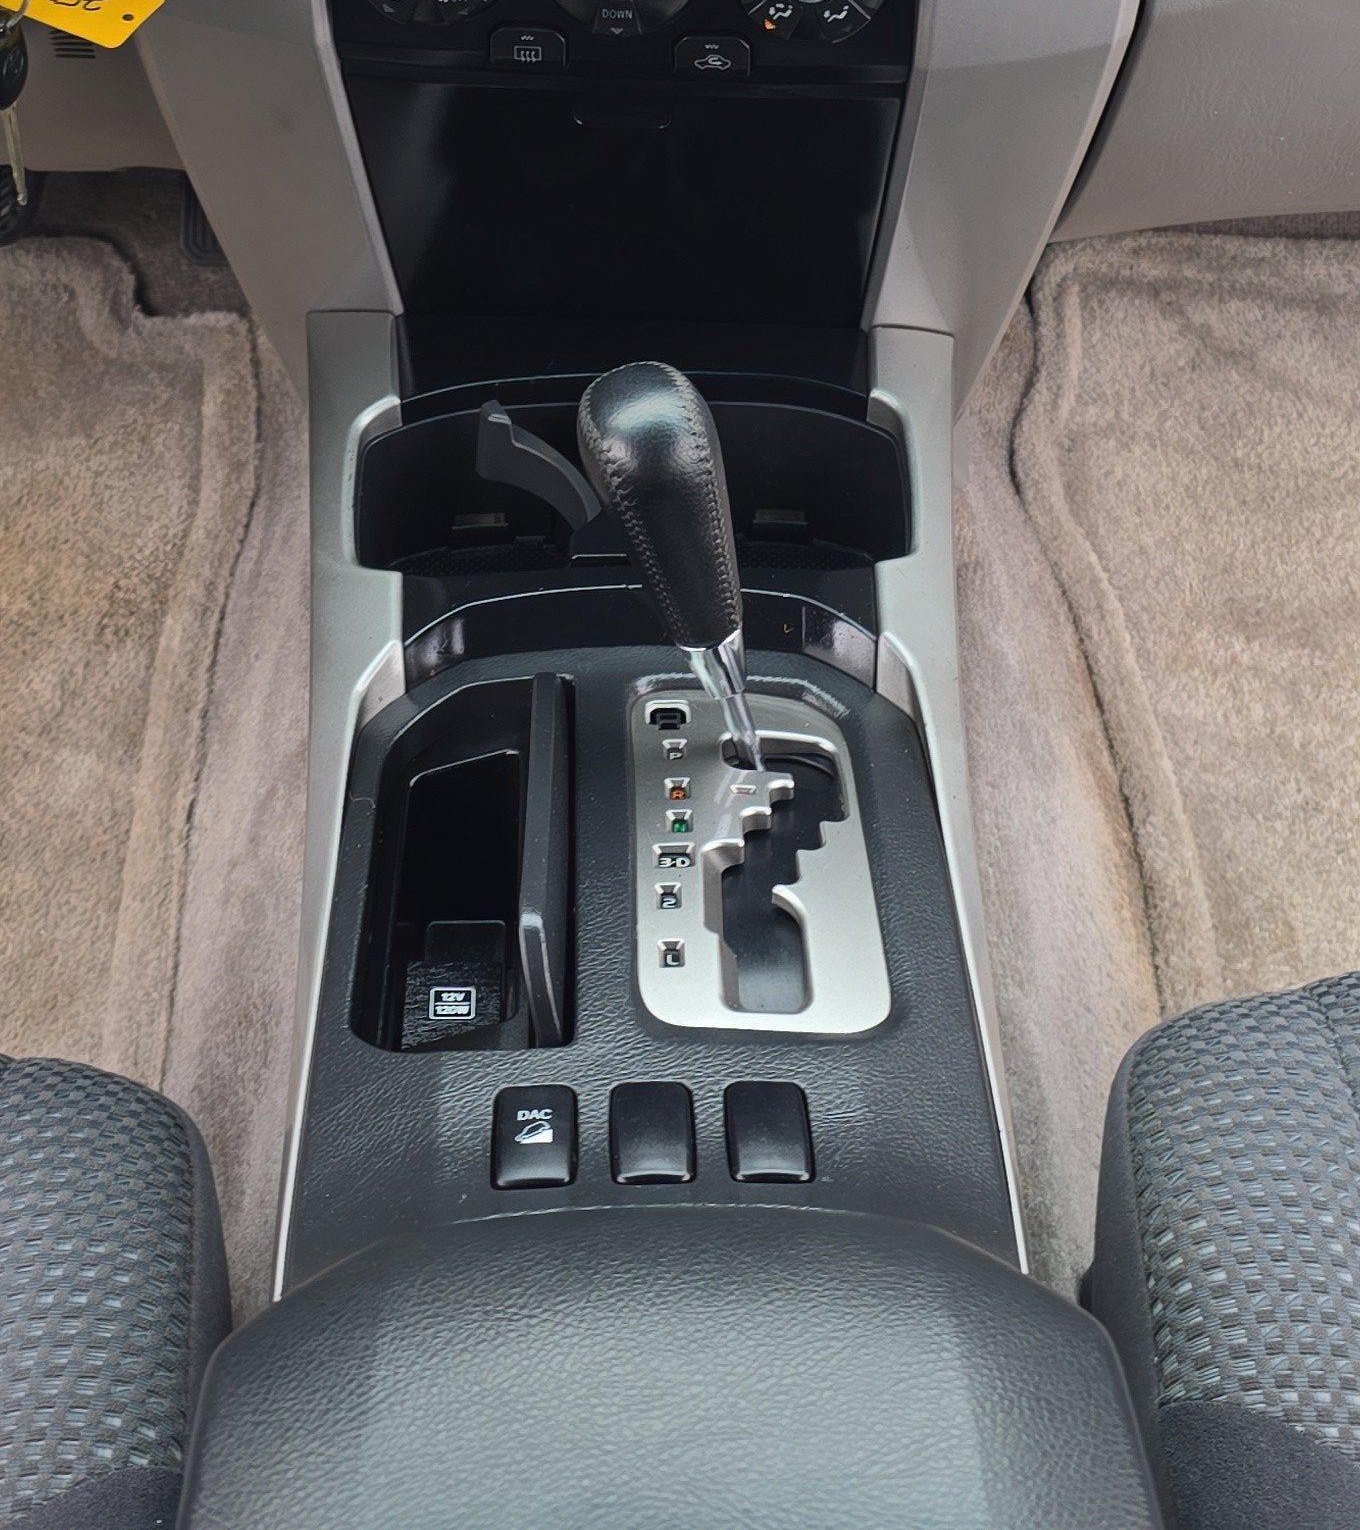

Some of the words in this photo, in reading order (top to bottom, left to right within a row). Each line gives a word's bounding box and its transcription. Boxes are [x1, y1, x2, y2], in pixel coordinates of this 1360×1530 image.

[601, 8, 633, 20] DOWN
[669, 752, 682, 760] P
[662, 898, 678, 908] 2
[666, 954, 680, 966] L
[441, 991, 466, 1002] 12V
[517, 1108, 554, 1121] DAC
